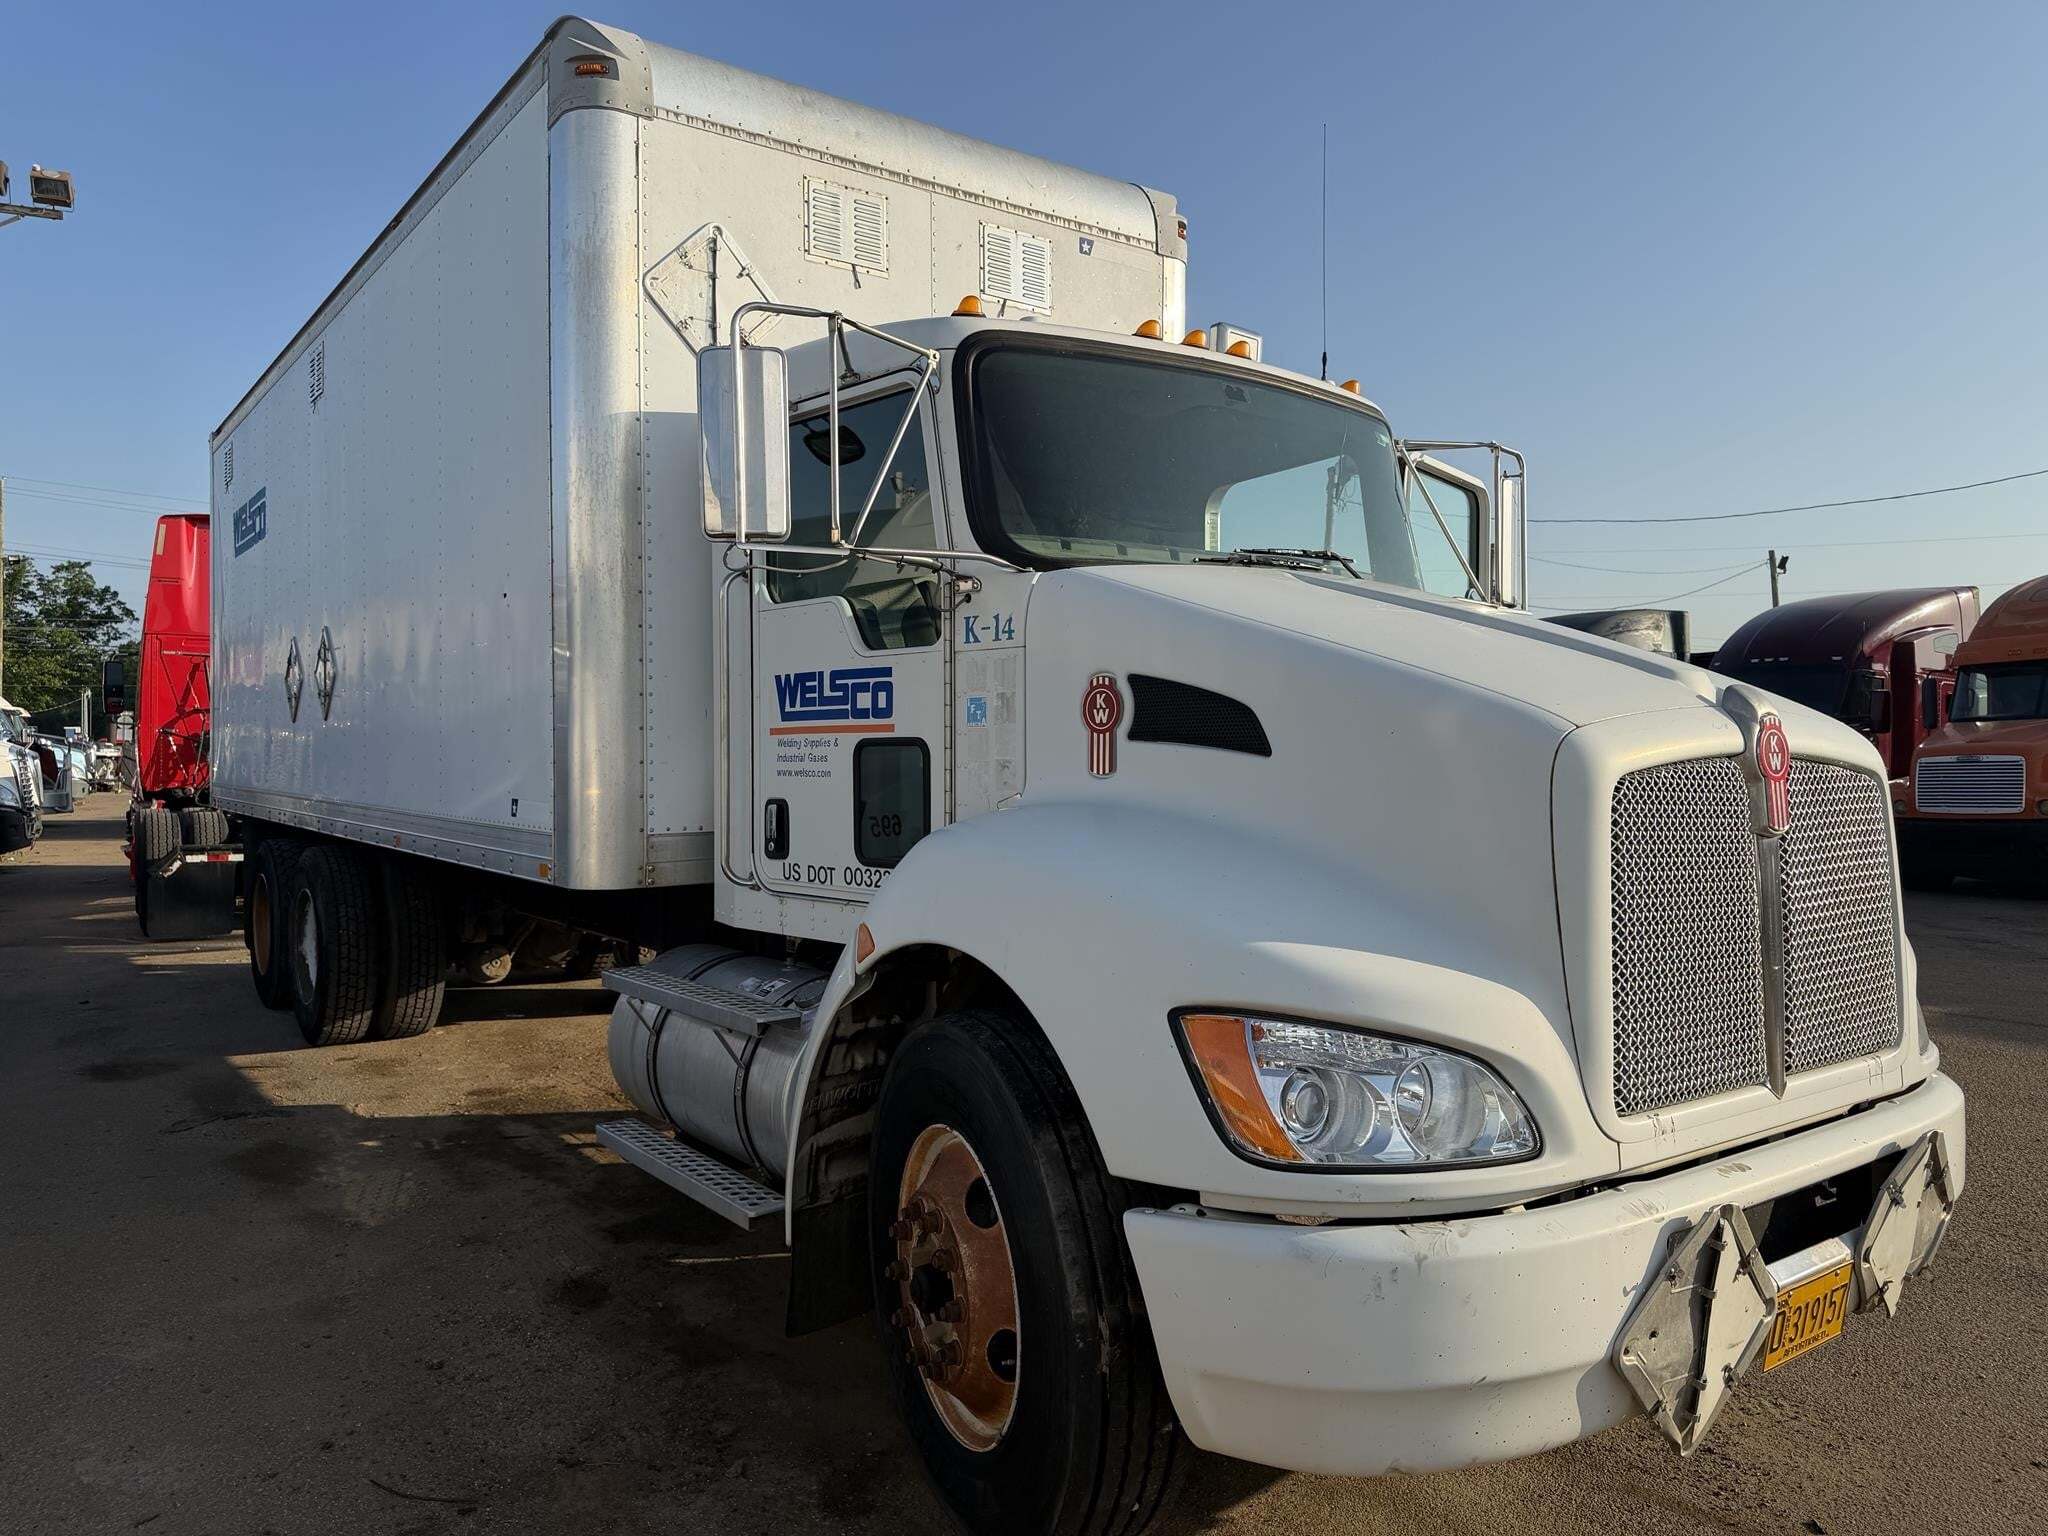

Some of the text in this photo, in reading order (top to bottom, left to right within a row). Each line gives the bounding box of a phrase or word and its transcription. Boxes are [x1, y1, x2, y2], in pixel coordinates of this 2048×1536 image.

[233, 486, 267, 559] WELSCO
[963, 613, 1016, 644] K-14
[774, 666, 894, 722] WELSCO
[777, 737, 839, 750] Welding Supplies &
[777, 752, 829, 763] Industrial Gases
[776, 768, 832, 778] www.welsco.com
[783, 862, 801, 882] US
[807, 864, 836, 886] DOT
